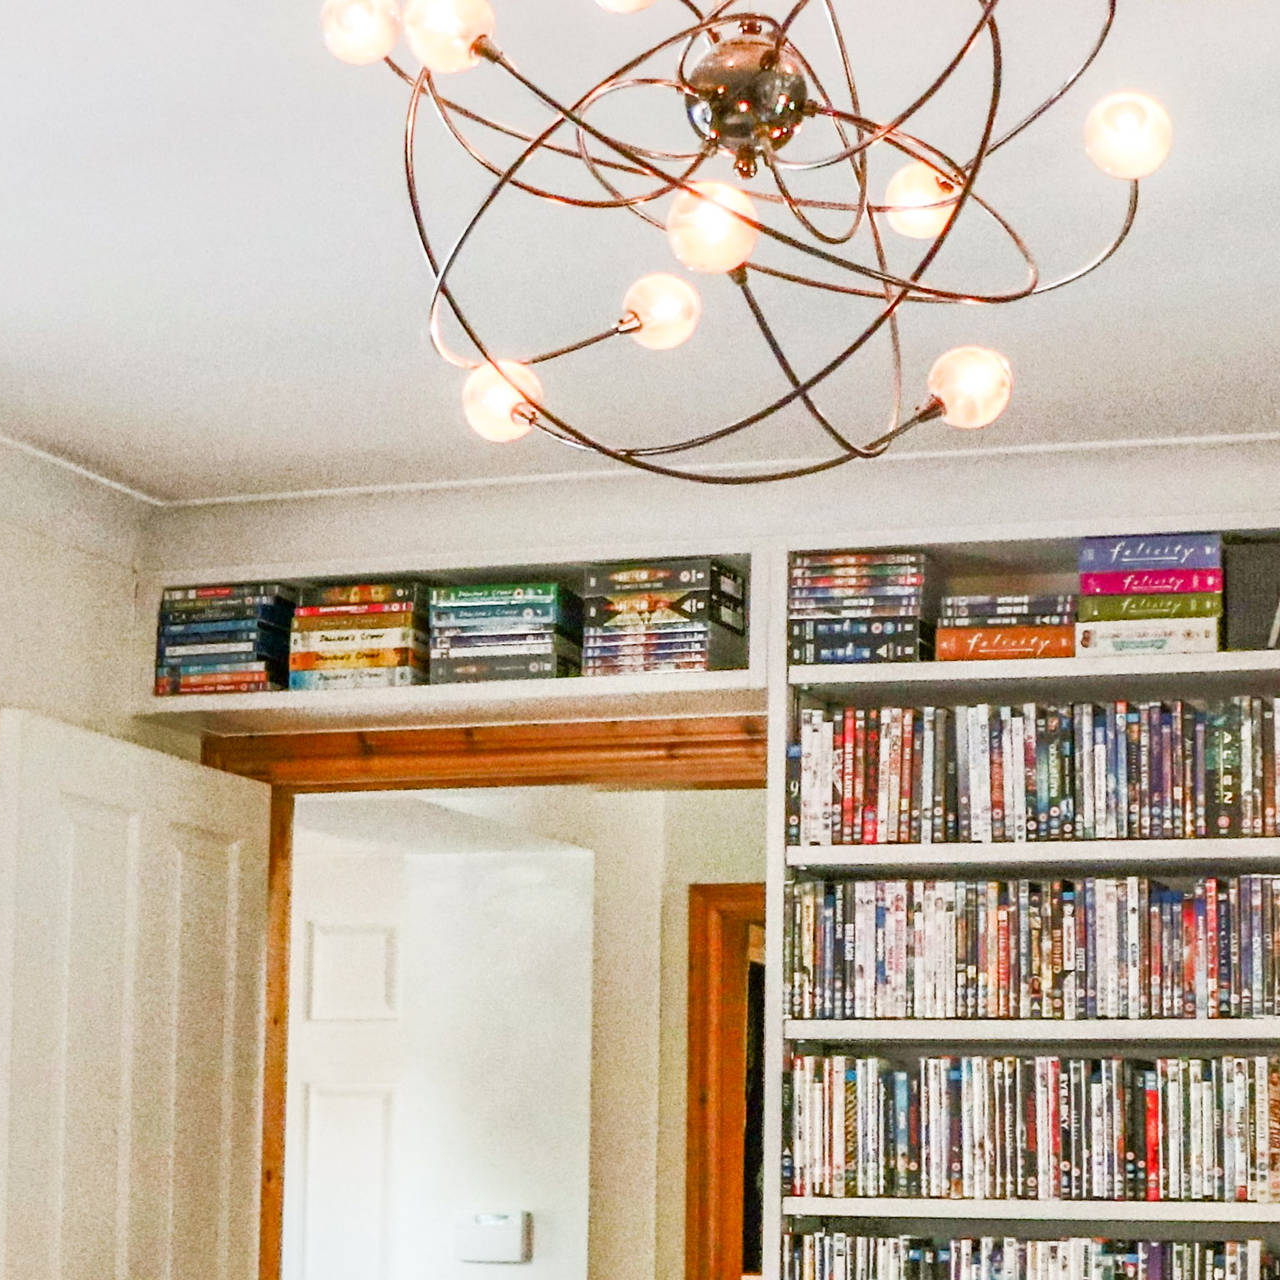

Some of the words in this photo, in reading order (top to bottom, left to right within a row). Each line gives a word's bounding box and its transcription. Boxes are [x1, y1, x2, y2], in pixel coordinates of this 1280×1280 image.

[1110, 541, 1194, 563] felicity
[1122, 574, 1185, 591] felicity
[967, 632, 1050, 655] felicity
[1223, 731, 1233, 804] ALIEN
